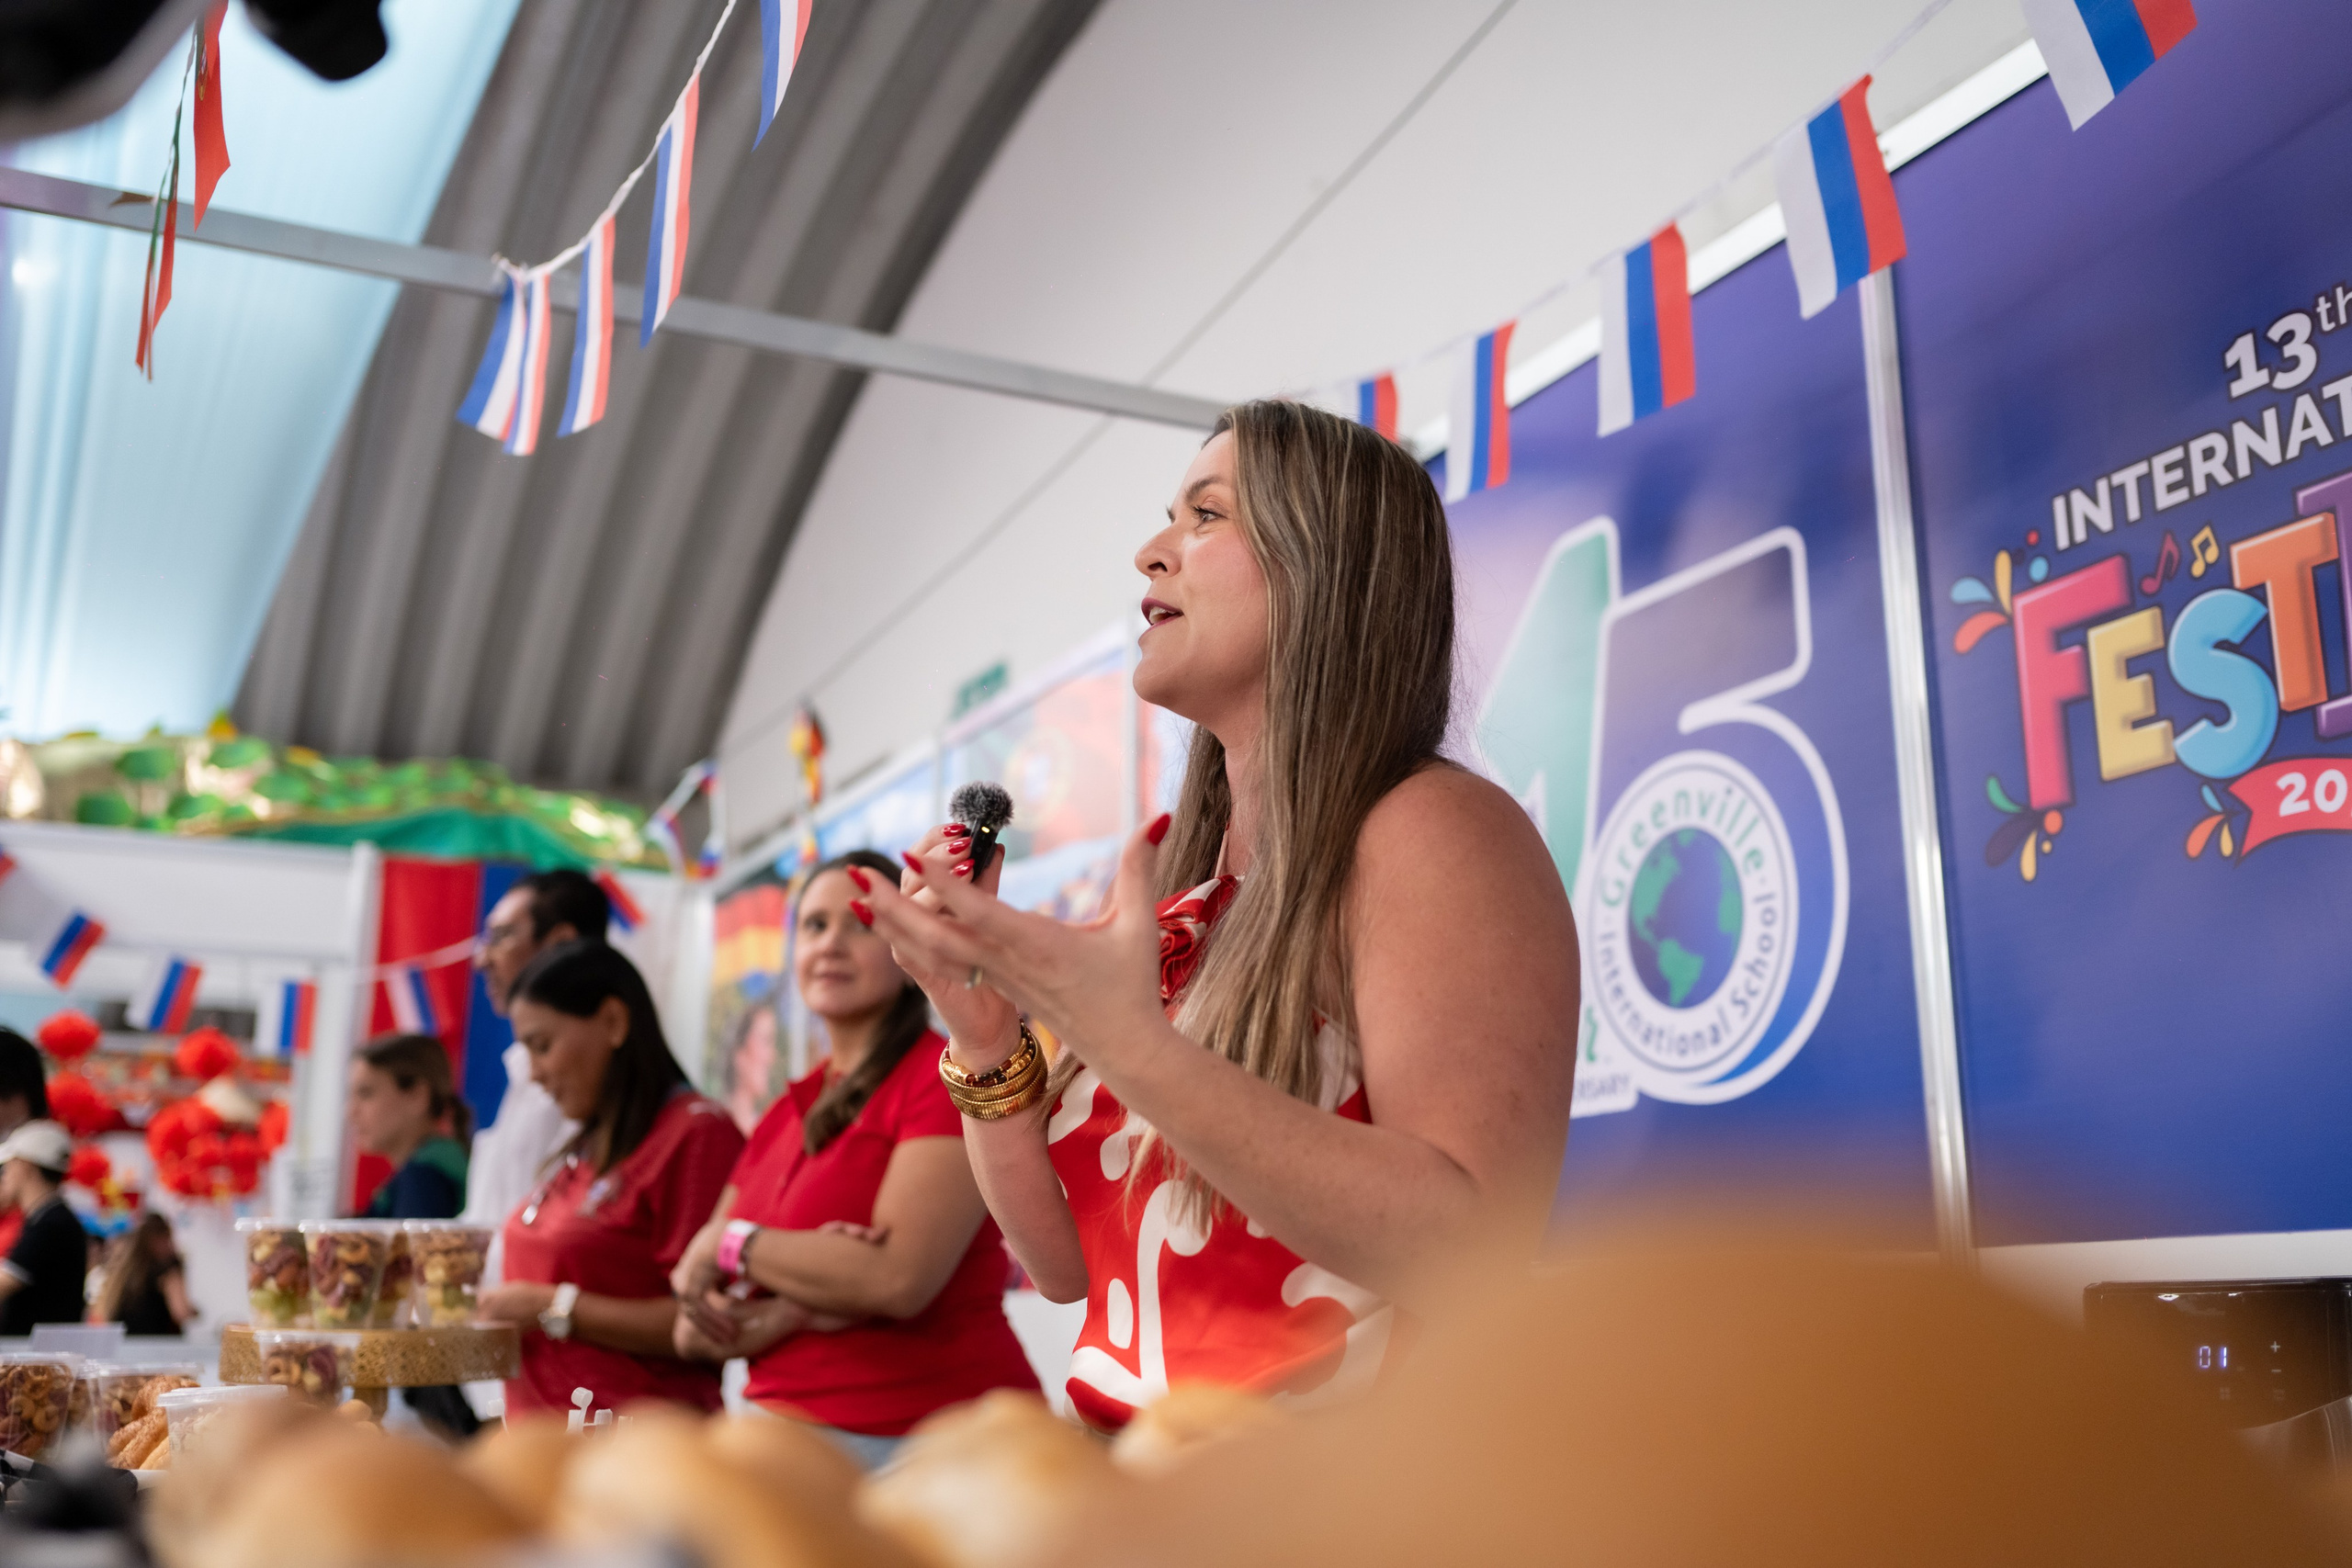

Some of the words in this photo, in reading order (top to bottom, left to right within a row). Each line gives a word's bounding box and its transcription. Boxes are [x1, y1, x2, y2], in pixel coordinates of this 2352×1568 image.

[2224, 285, 2352, 399] 13th
[2052, 376, 2352, 551] INTERNAT
[1600, 785, 1765, 908] Greenville
[2276, 768, 2352, 818] 20
[1599, 930, 1732, 1057] International
[1729, 890, 1778, 1019] School
[2199, 1345, 2227, 1369] 01
